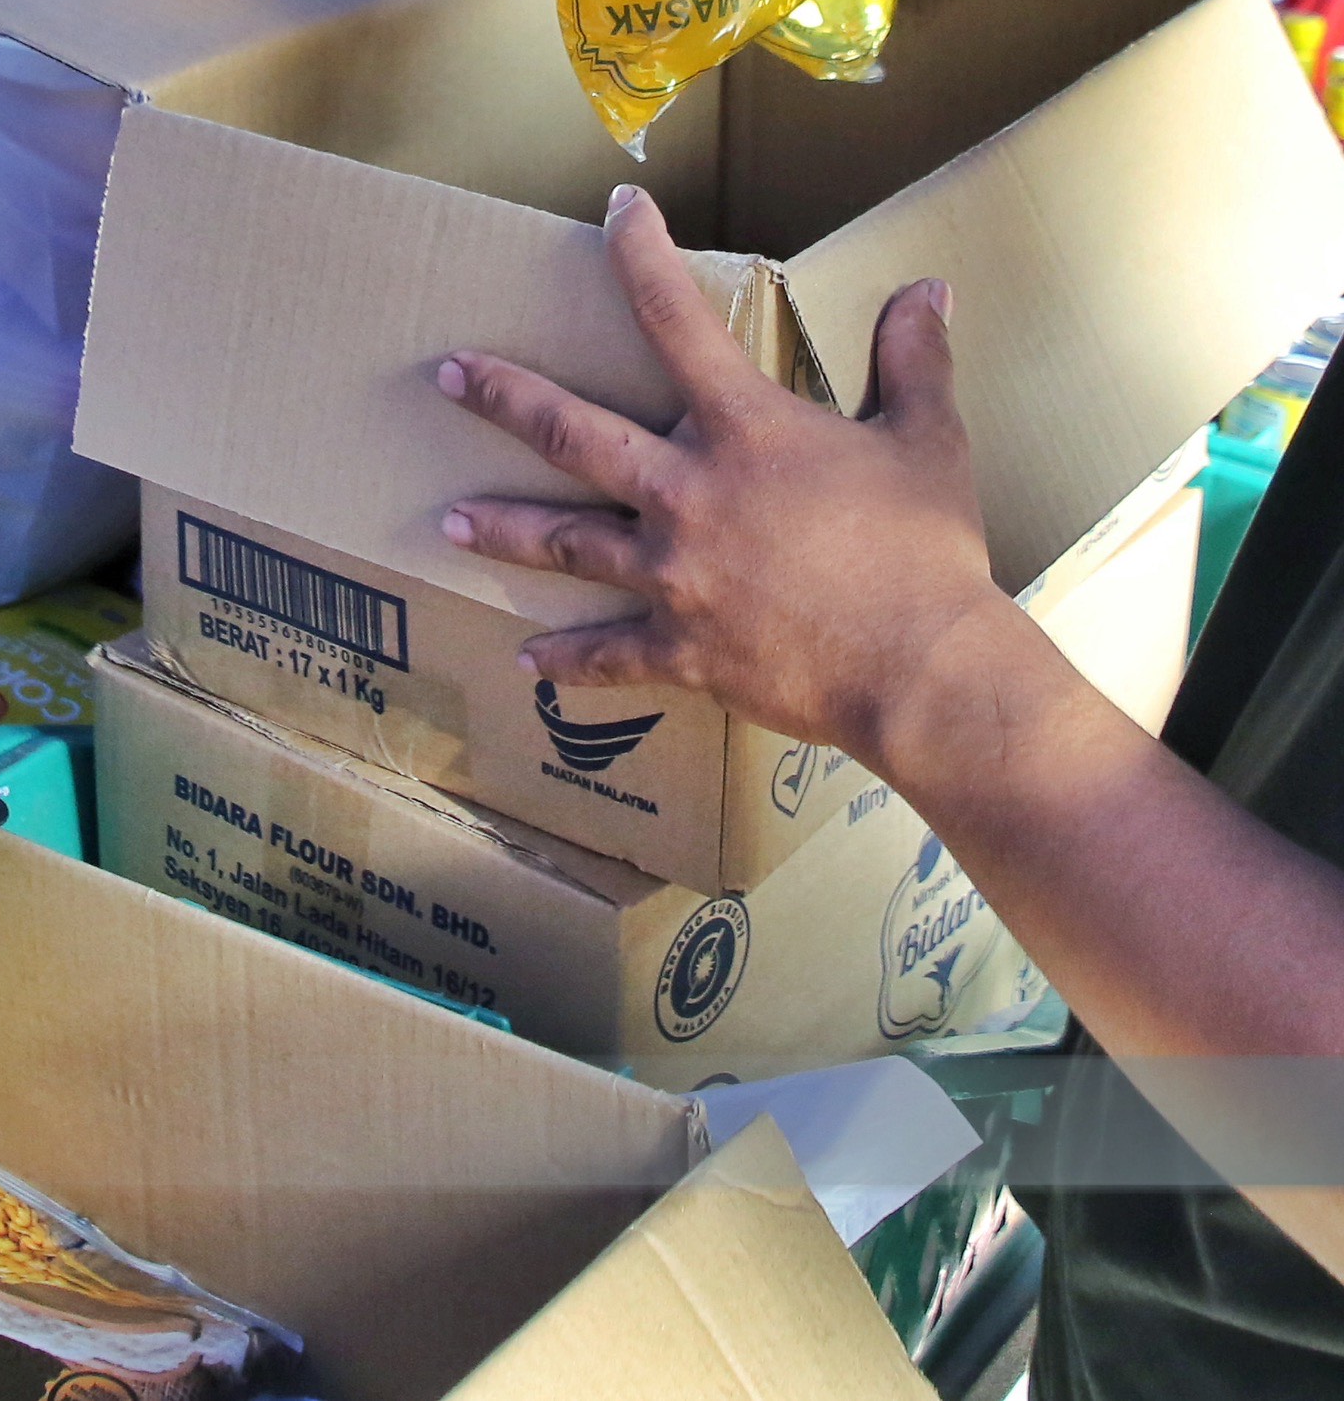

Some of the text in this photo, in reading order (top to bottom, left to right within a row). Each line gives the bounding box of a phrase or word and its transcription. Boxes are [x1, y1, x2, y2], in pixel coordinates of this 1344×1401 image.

[199, 611, 271, 661] BERAT
[289, 649, 313, 678] 17
[337, 668, 347, 694] 1
[354, 673, 386, 715] Kg
[541, 761, 658, 816] BUATAN MALAYSIA
[847, 784, 895, 827] Miny
[164, 855, 251, 923] Seksyen
[166, 824, 200, 863] No.
[206, 848, 224, 879] 1,
[229, 861, 289, 909] Jalan
[294, 892, 348, 939] Lada
[356, 924, 424, 979] Hitam
[174, 774, 497, 955] BIDARA FLOUR SDN. BHD.
[897, 888, 987, 978] Bidar
